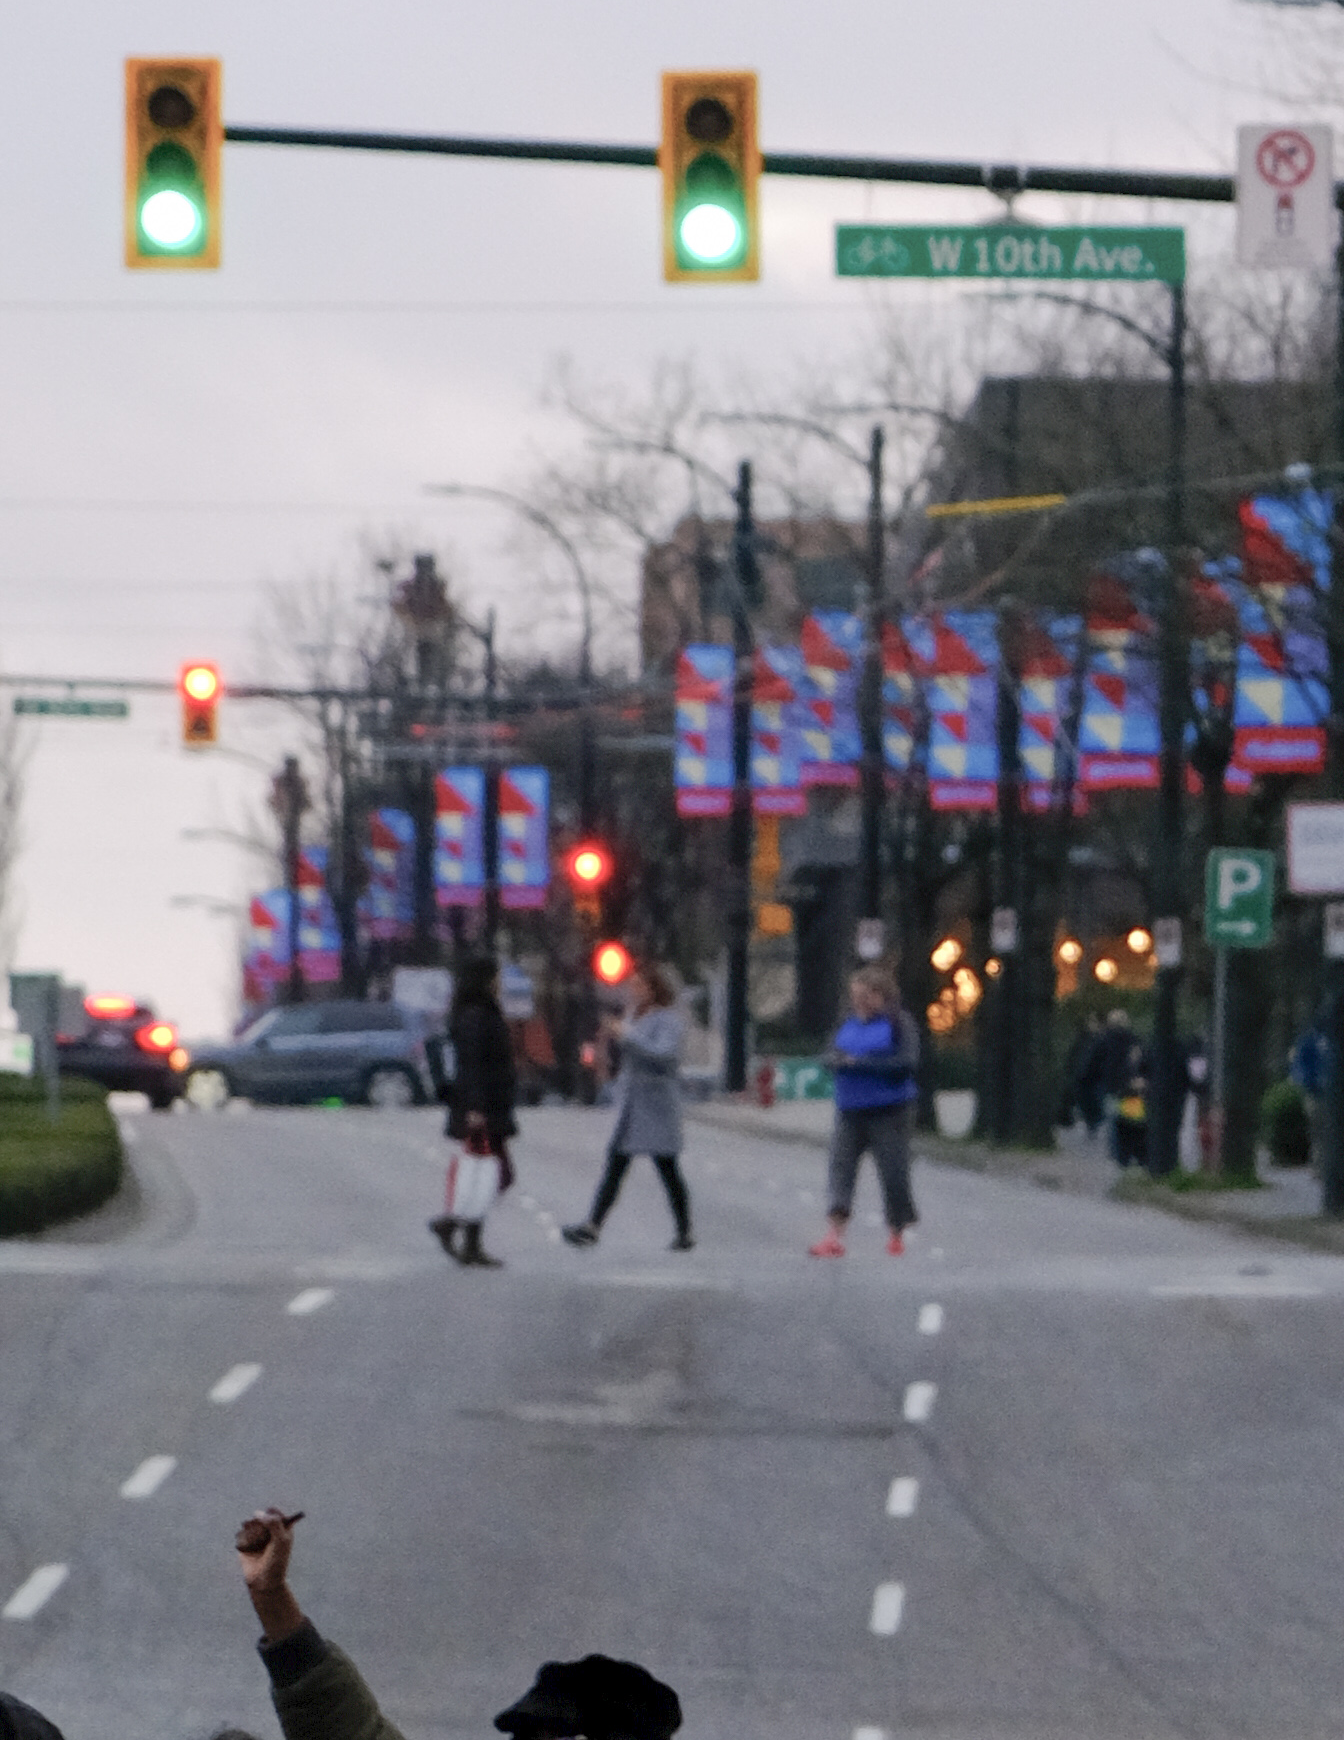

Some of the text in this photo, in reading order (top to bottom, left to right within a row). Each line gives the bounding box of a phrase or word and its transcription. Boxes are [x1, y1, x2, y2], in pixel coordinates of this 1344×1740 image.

[926, 234, 1156, 274] W 10th Ave.
[1217, 858, 1263, 910] P
